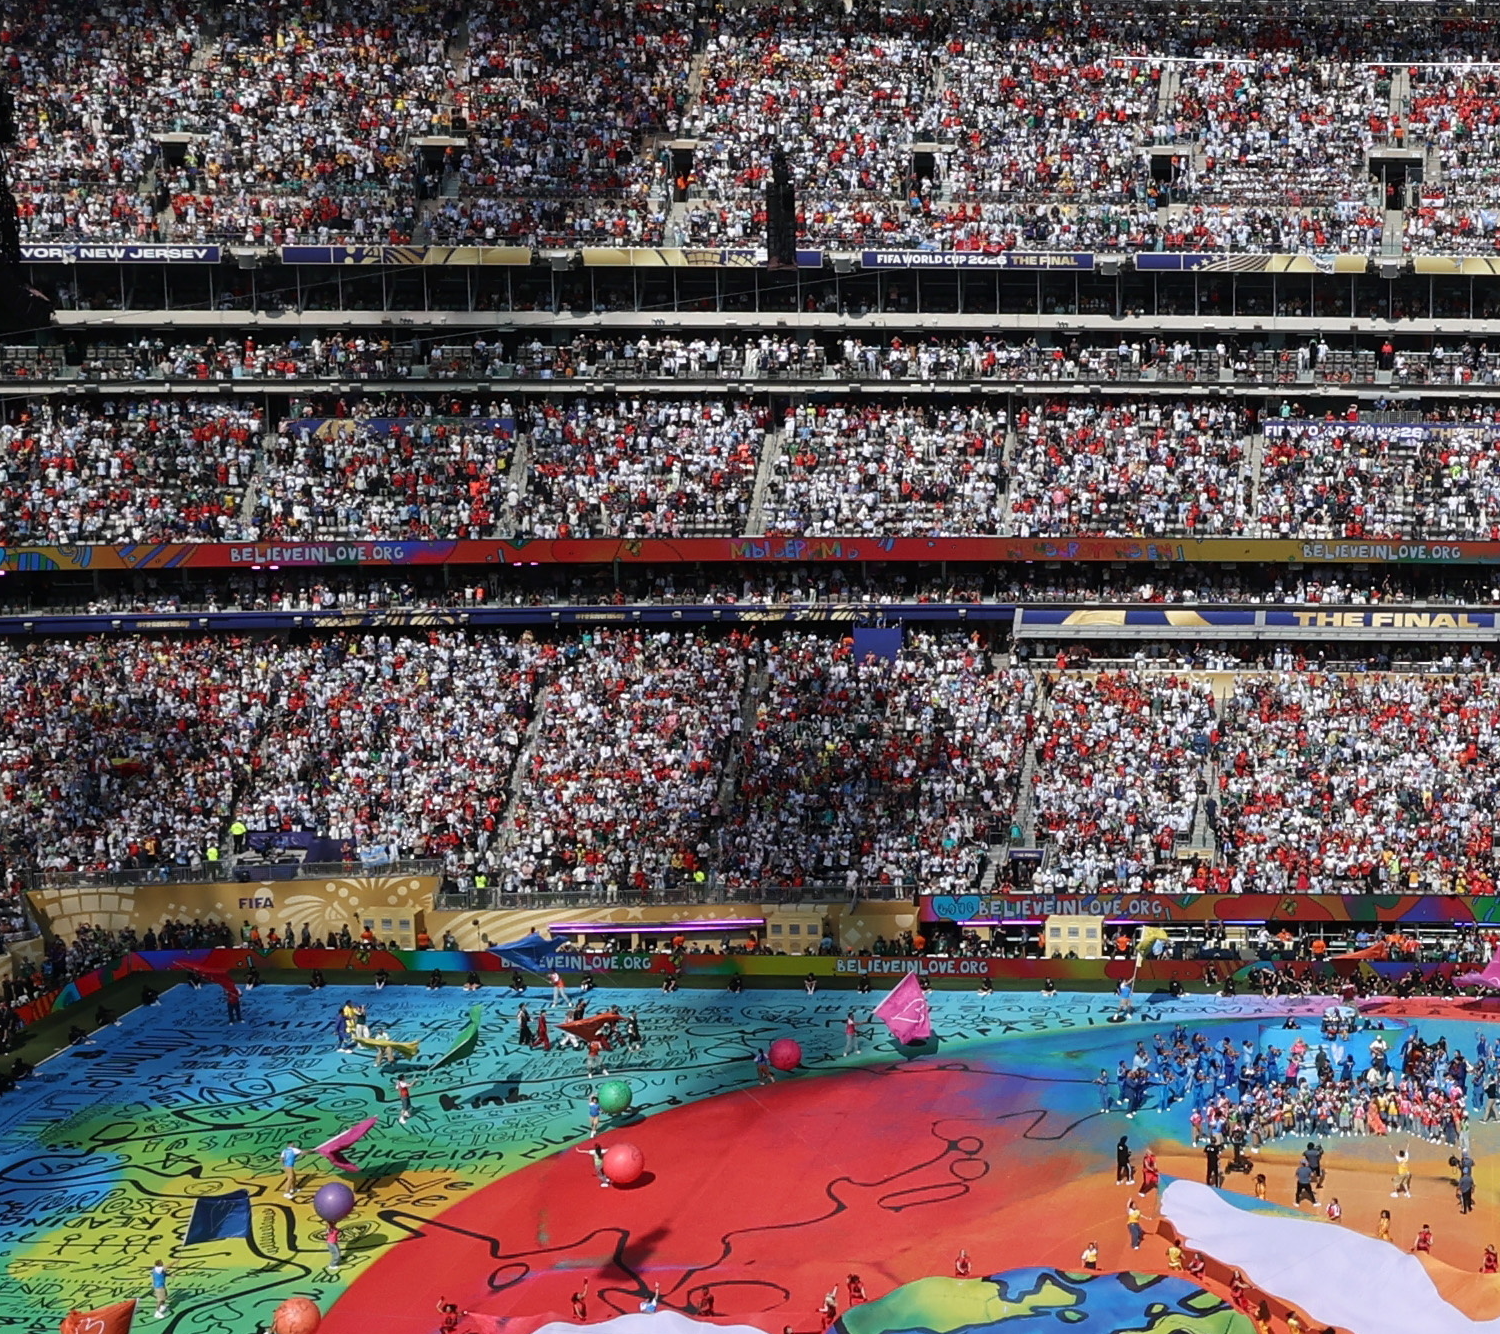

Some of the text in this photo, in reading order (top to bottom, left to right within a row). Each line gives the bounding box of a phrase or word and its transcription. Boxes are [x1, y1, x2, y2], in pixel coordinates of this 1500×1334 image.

[80, 248, 125, 259] NEW
[129, 248, 208, 259] JERSEY
[877, 255, 1078, 265] FIFA WORLD CUP 2026 THE FINAL
[230, 541, 406, 565] BELIEVEINLOVE.ORG
[1302, 545, 1461, 561] BELIEVEINLOVE.ORG
[1292, 612, 1479, 628] THE FINAL
[239, 897, 274, 909] FIFA
[978, 900, 1162, 916] BELIEVEINLOVE.ORG
[836, 958, 988, 976] BELIEVEINLOVE.ORG
